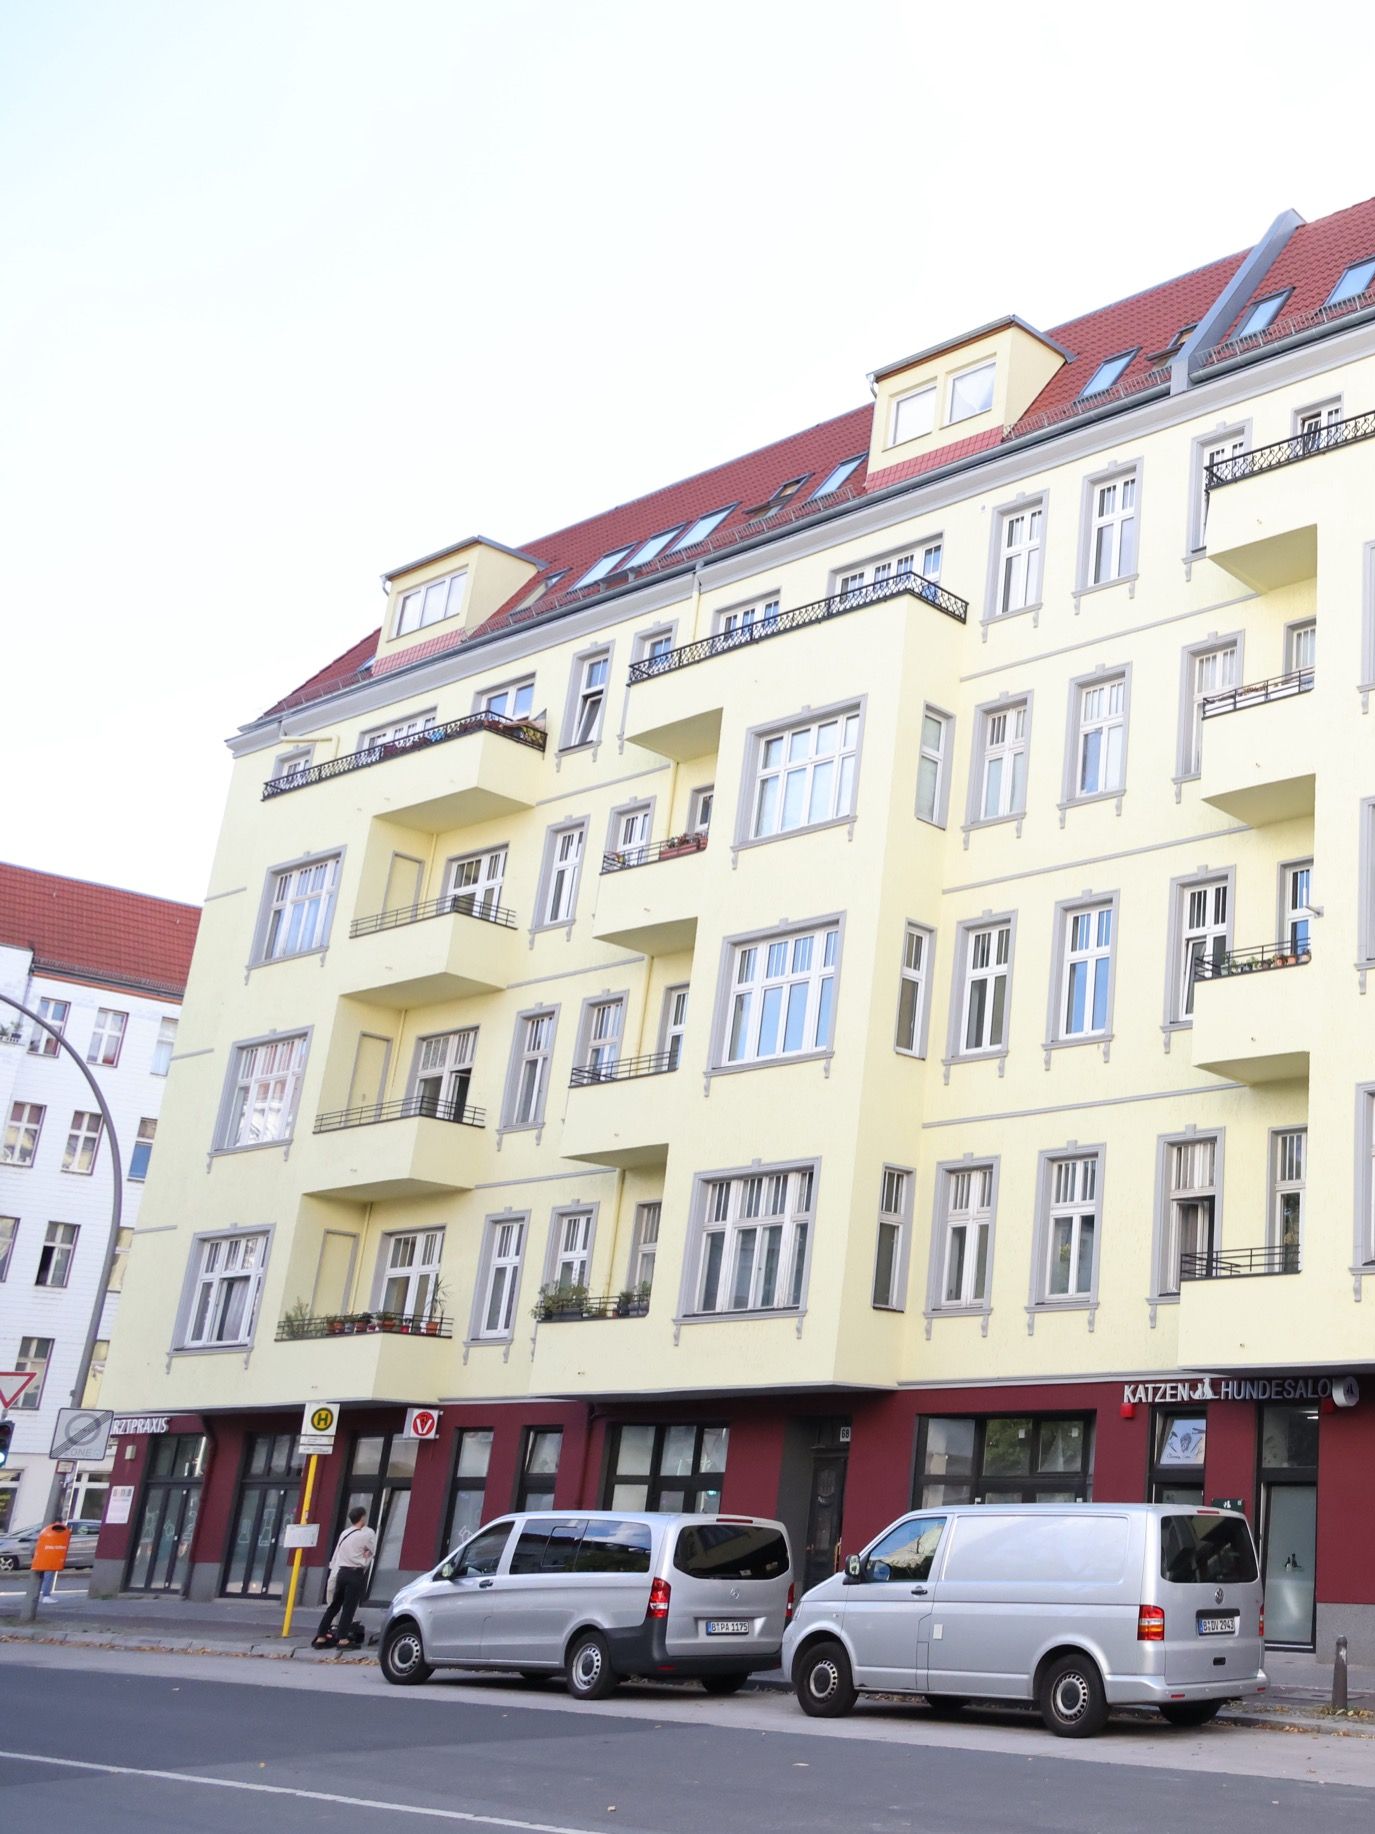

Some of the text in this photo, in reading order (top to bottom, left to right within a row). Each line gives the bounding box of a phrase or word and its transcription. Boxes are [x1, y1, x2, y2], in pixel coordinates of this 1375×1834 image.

[1123, 1379, 1333, 1403] KATZEN HUNDESALO
[110, 1417, 169, 1434] RZTPRAXIS
[841, 1428, 850, 1439] 68
